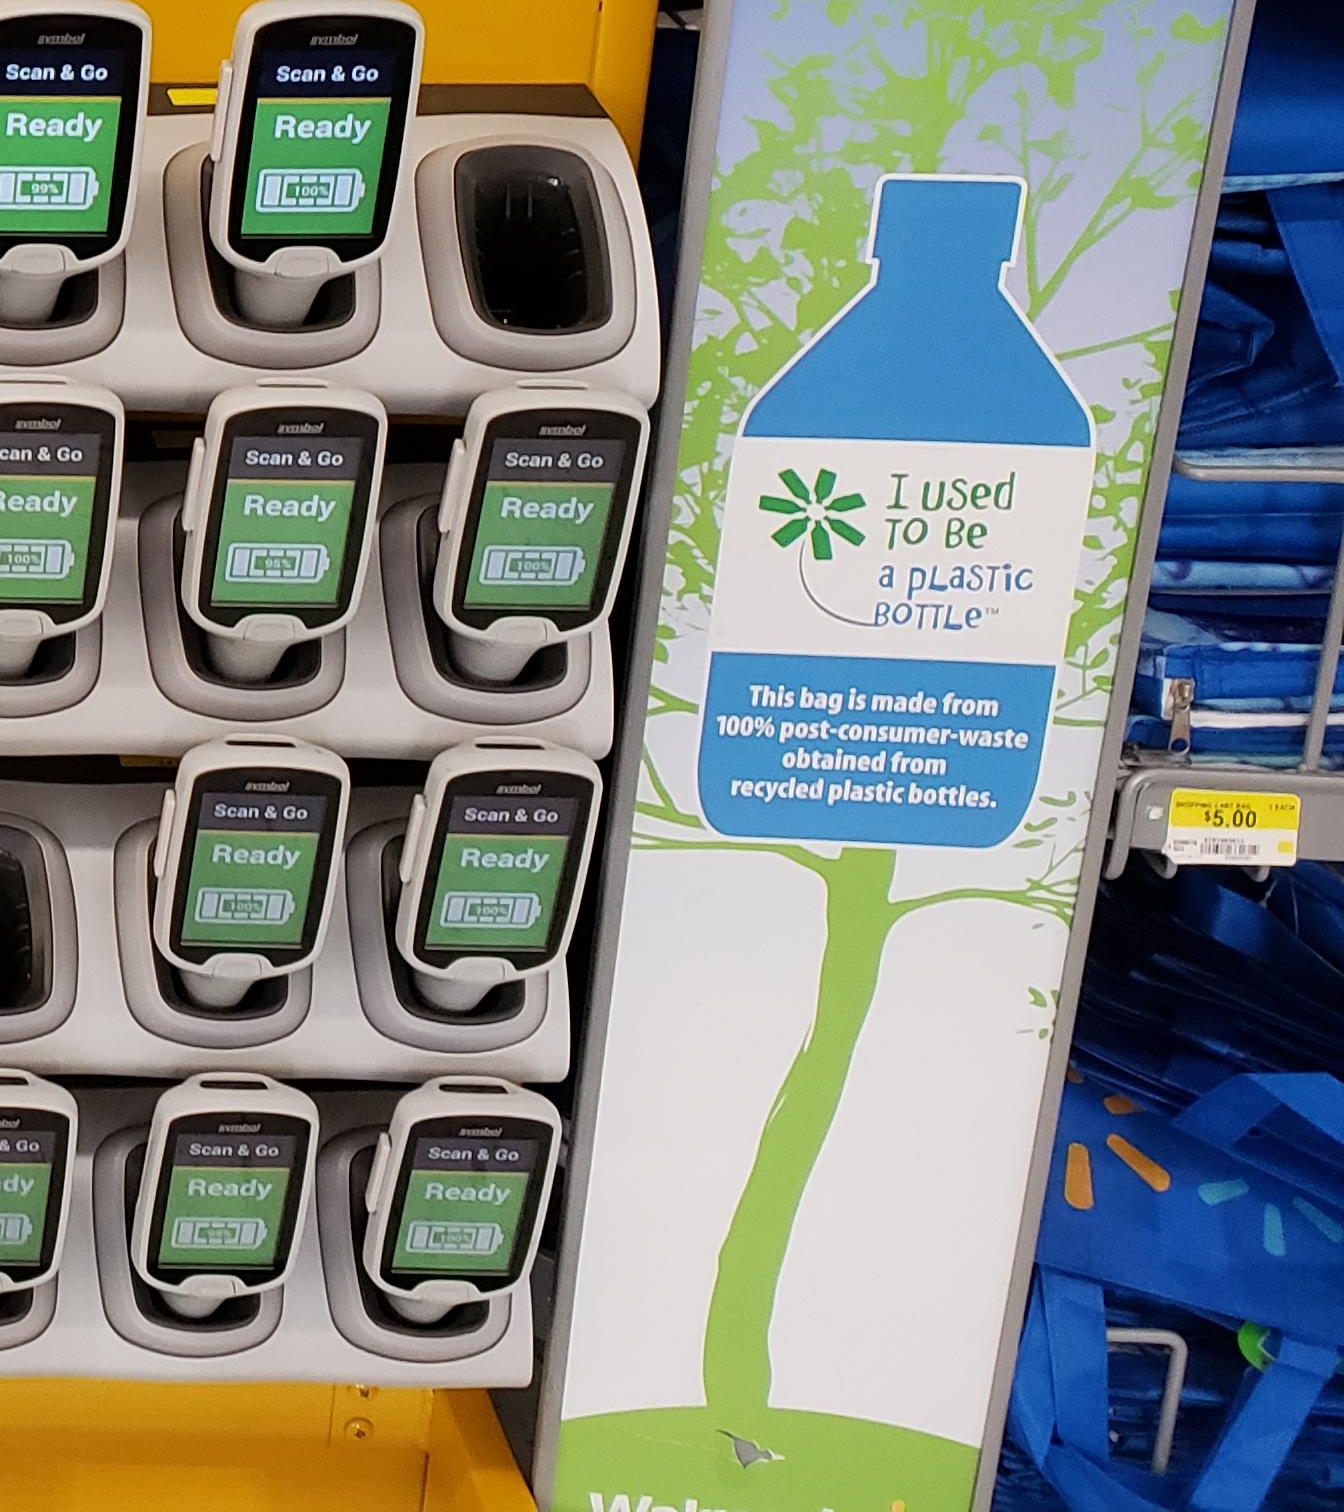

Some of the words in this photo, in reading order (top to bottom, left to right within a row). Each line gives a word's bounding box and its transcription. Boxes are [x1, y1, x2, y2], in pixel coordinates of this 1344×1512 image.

[6, 64, 55, 80] Scan
[60, 65, 74, 80] &
[81, 65, 108, 80] Go
[276, 66, 326, 82] Scan
[331, 66, 345, 82] &
[352, 66, 379, 81] Go
[6, 112, 103, 142] Ready
[275, 114, 372, 144] Ready
[37, 447, 50, 461] &
[57, 447, 82, 461] Go
[246, 451, 292, 465] Scan
[298, 451, 311, 465] &
[318, 452, 344, 465] Go
[506, 453, 552, 467] Scan
[558, 453, 571, 467] &
[577, 454, 603, 467] Go
[886, 473, 909, 510] I
[244, 495, 336, 522] Ready
[501, 497, 594, 523] Ready
[879, 565, 894, 588] a
[750, 685, 795, 708] This
[800, 688, 842, 715] bag
[849, 689, 867, 711] is
[871, 690, 937, 714] made
[941, 692, 999, 717] from
[716, 716, 775, 738] 100%
[780, 719, 1029, 750] post-consumer-waste
[782, 748, 885, 773] obtained
[890, 751, 946, 775] from
[730, 778, 823, 805] recycled
[828, 782, 903, 806] plastic
[908, 784, 997, 809] bottles.
[1205, 810, 1256, 828] $5.00
[212, 844, 300, 869] Ready
[461, 848, 550, 872] Ready
[188, 1179, 272, 1200] Ready
[425, 1183, 511, 1205] Ready
